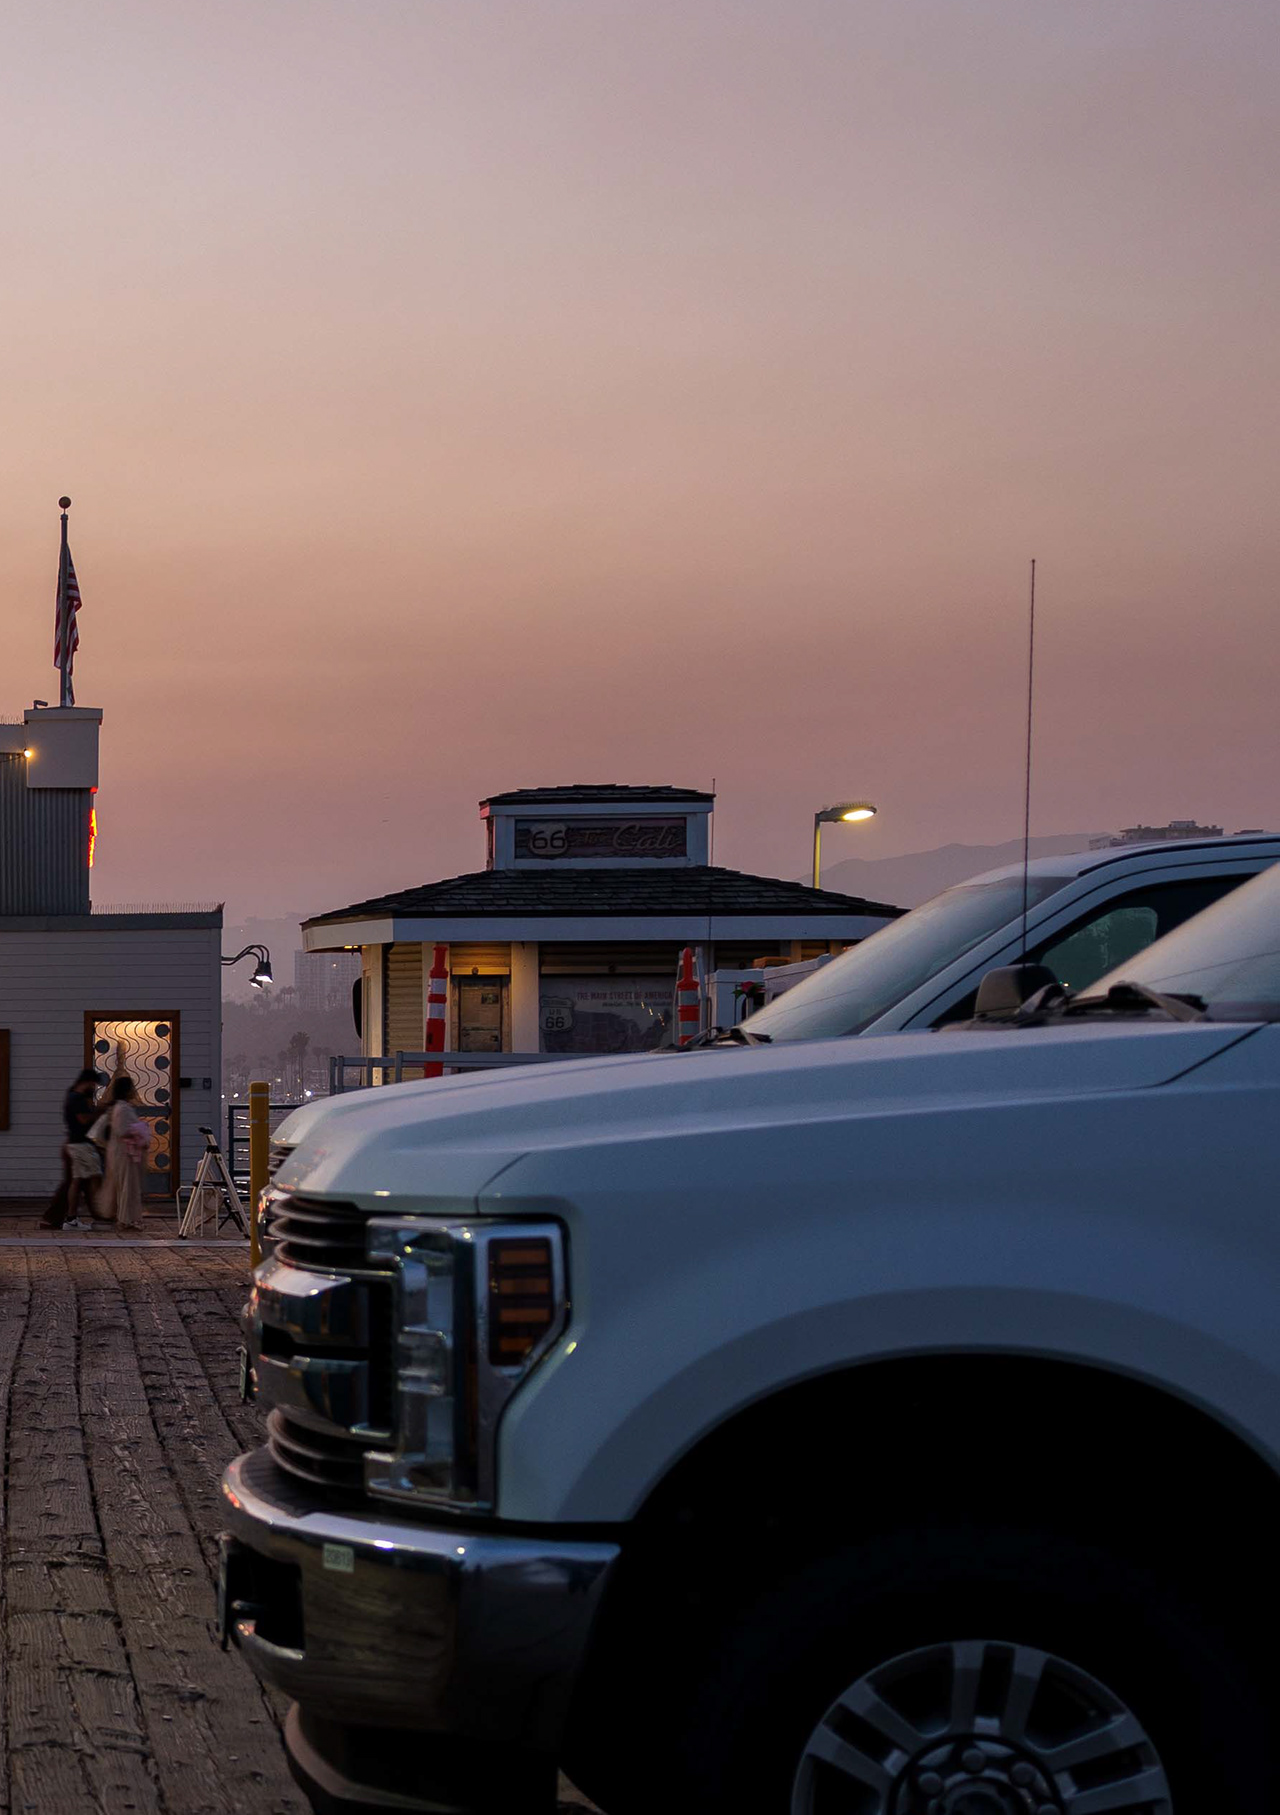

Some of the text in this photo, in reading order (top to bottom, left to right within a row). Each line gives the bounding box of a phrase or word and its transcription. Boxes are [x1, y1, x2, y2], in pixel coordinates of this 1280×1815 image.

[532, 830, 566, 849] 66
[613, 823, 681, 850] Cali
[609, 991, 633, 1000] STREET
[545, 1016, 564, 1029] 66
